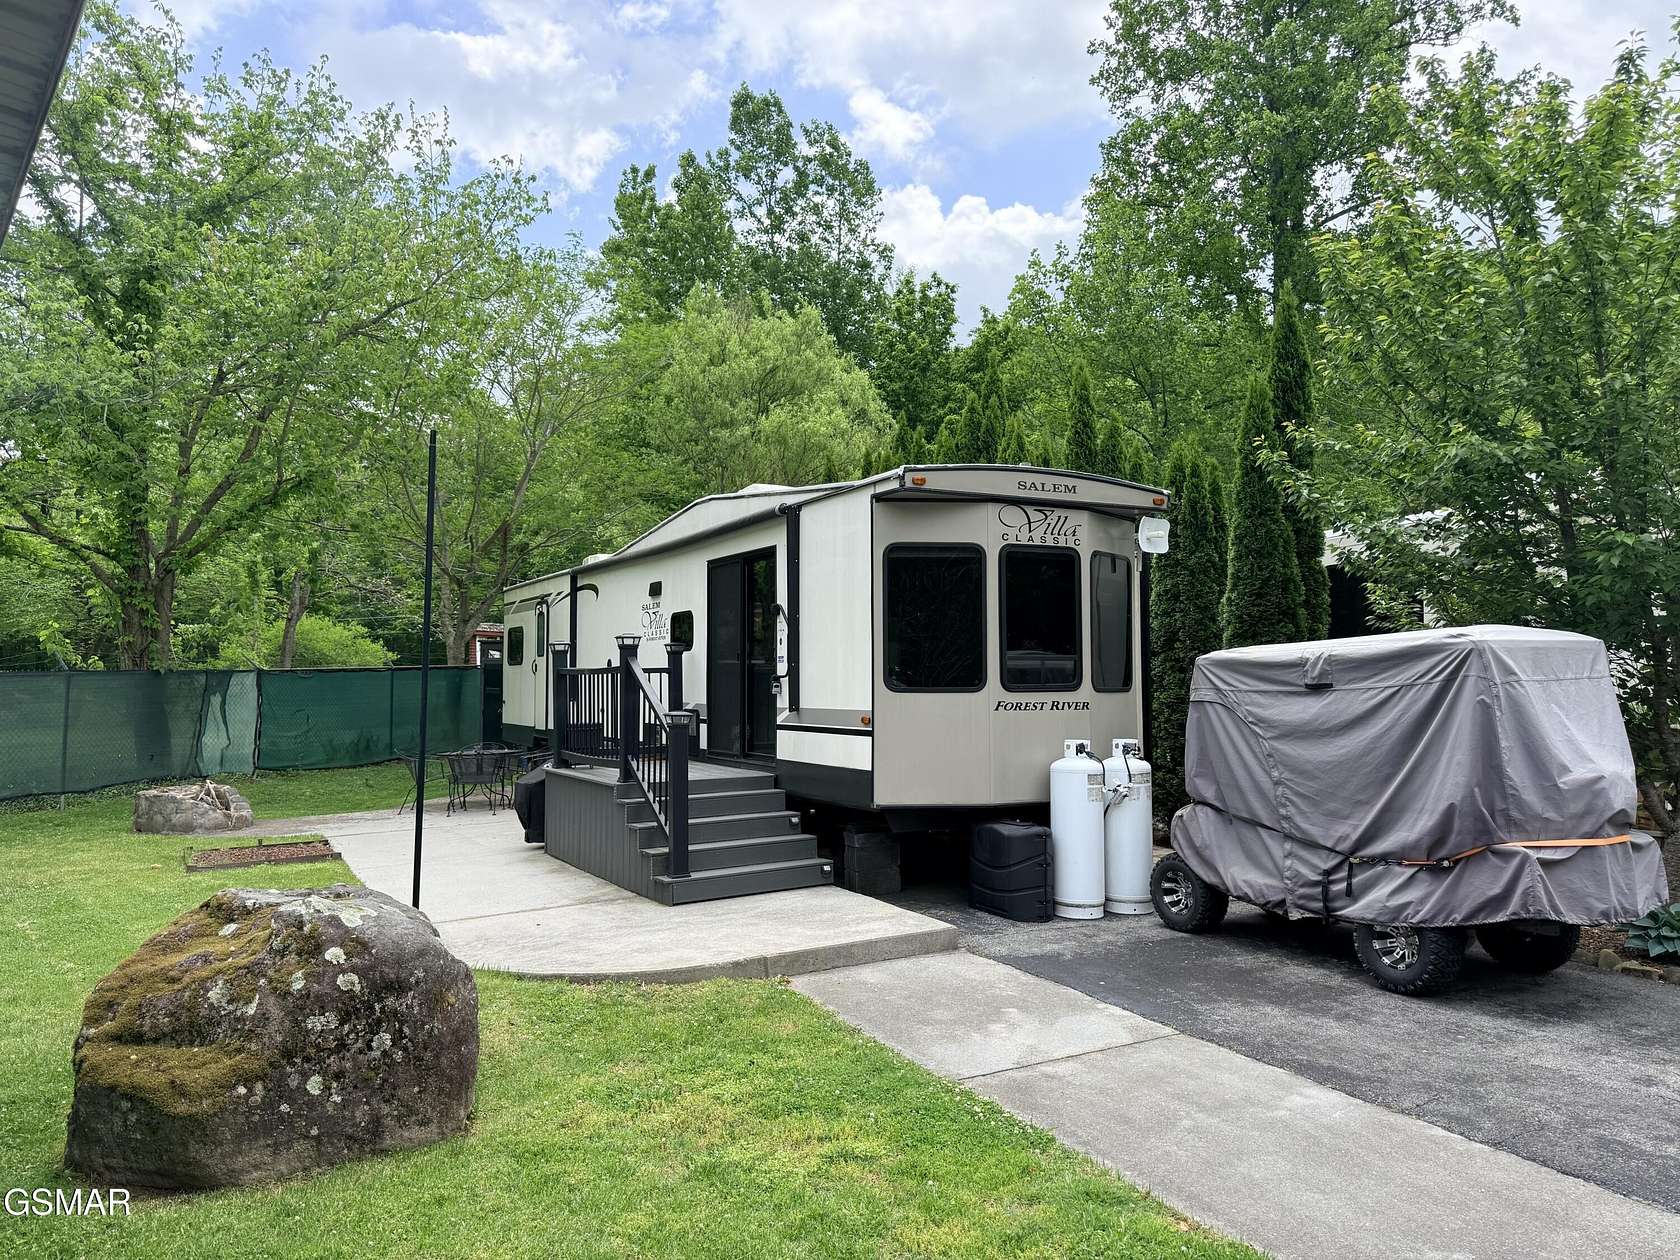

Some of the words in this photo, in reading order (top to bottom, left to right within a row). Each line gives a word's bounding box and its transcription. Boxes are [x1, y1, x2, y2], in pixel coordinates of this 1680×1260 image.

[1017, 480, 1077, 494] SALEM
[998, 504, 1082, 537] Villa
[1001, 532, 1081, 546] CLASSIC
[641, 601, 661, 611] SALEM
[643, 628, 669, 638] CLASSIC
[994, 700, 1047, 711] FOREST
[1050, 700, 1090, 711] RIVER
